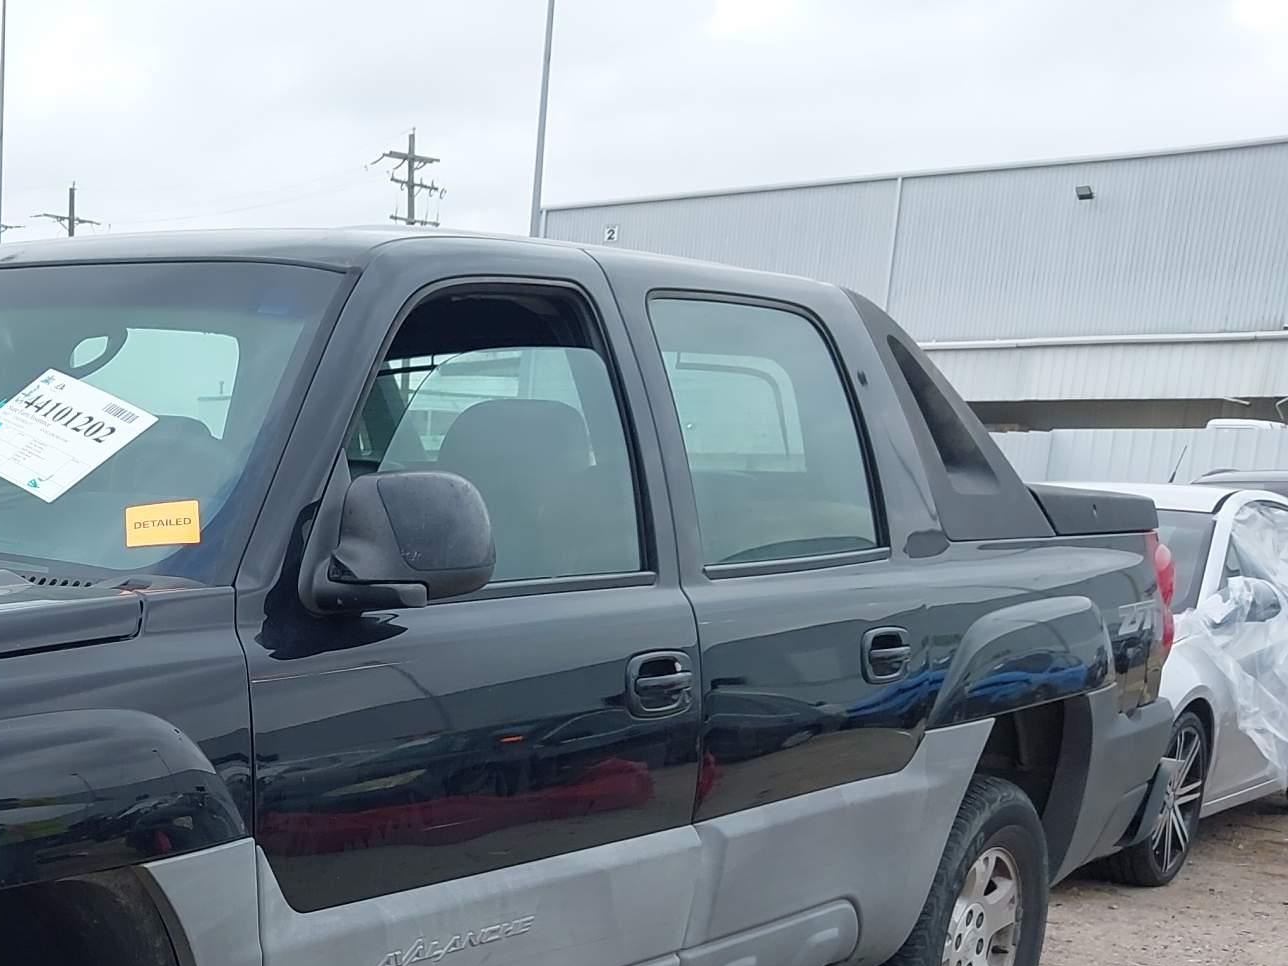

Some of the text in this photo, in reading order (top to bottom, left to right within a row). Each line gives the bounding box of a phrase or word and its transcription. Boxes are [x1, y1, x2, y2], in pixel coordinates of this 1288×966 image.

[606, 228, 616, 241] 2
[23, 394, 117, 444] 44101202
[133, 517, 192, 530] DETAILED
